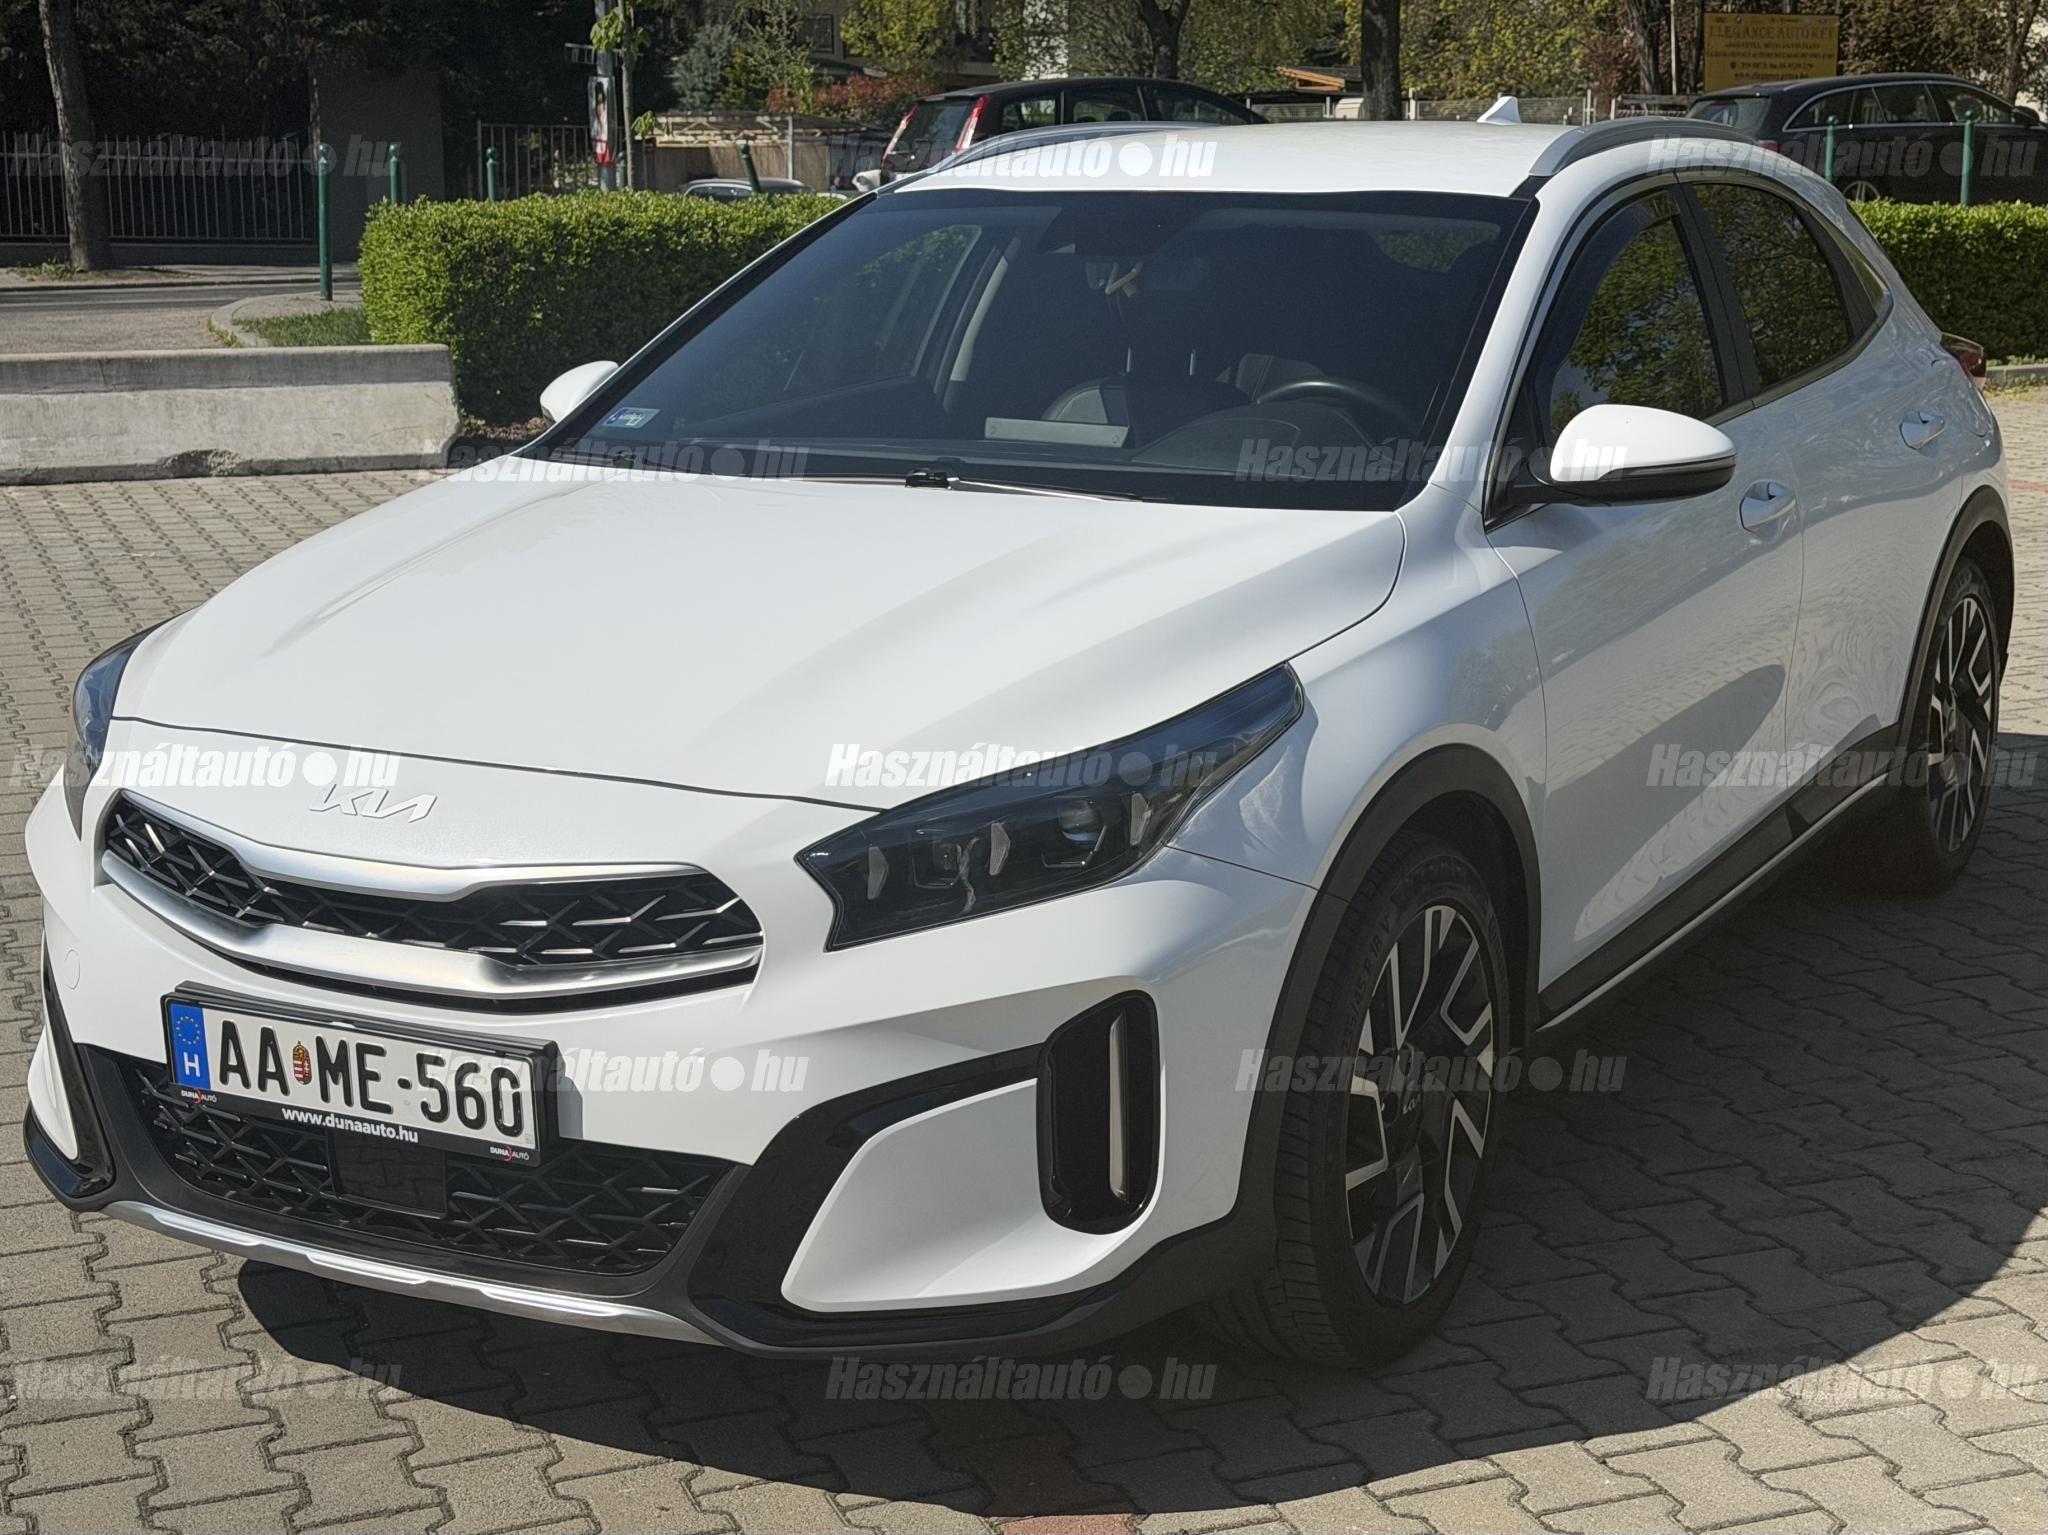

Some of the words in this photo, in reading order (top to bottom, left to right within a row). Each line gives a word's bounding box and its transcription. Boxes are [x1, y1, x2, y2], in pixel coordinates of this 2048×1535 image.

[183, 1051, 201, 1078] H
[218, 1020, 290, 1097] AA
[315, 1034, 525, 1138] ME-560
[281, 1107, 419, 1144] www.dunaauto.hu
